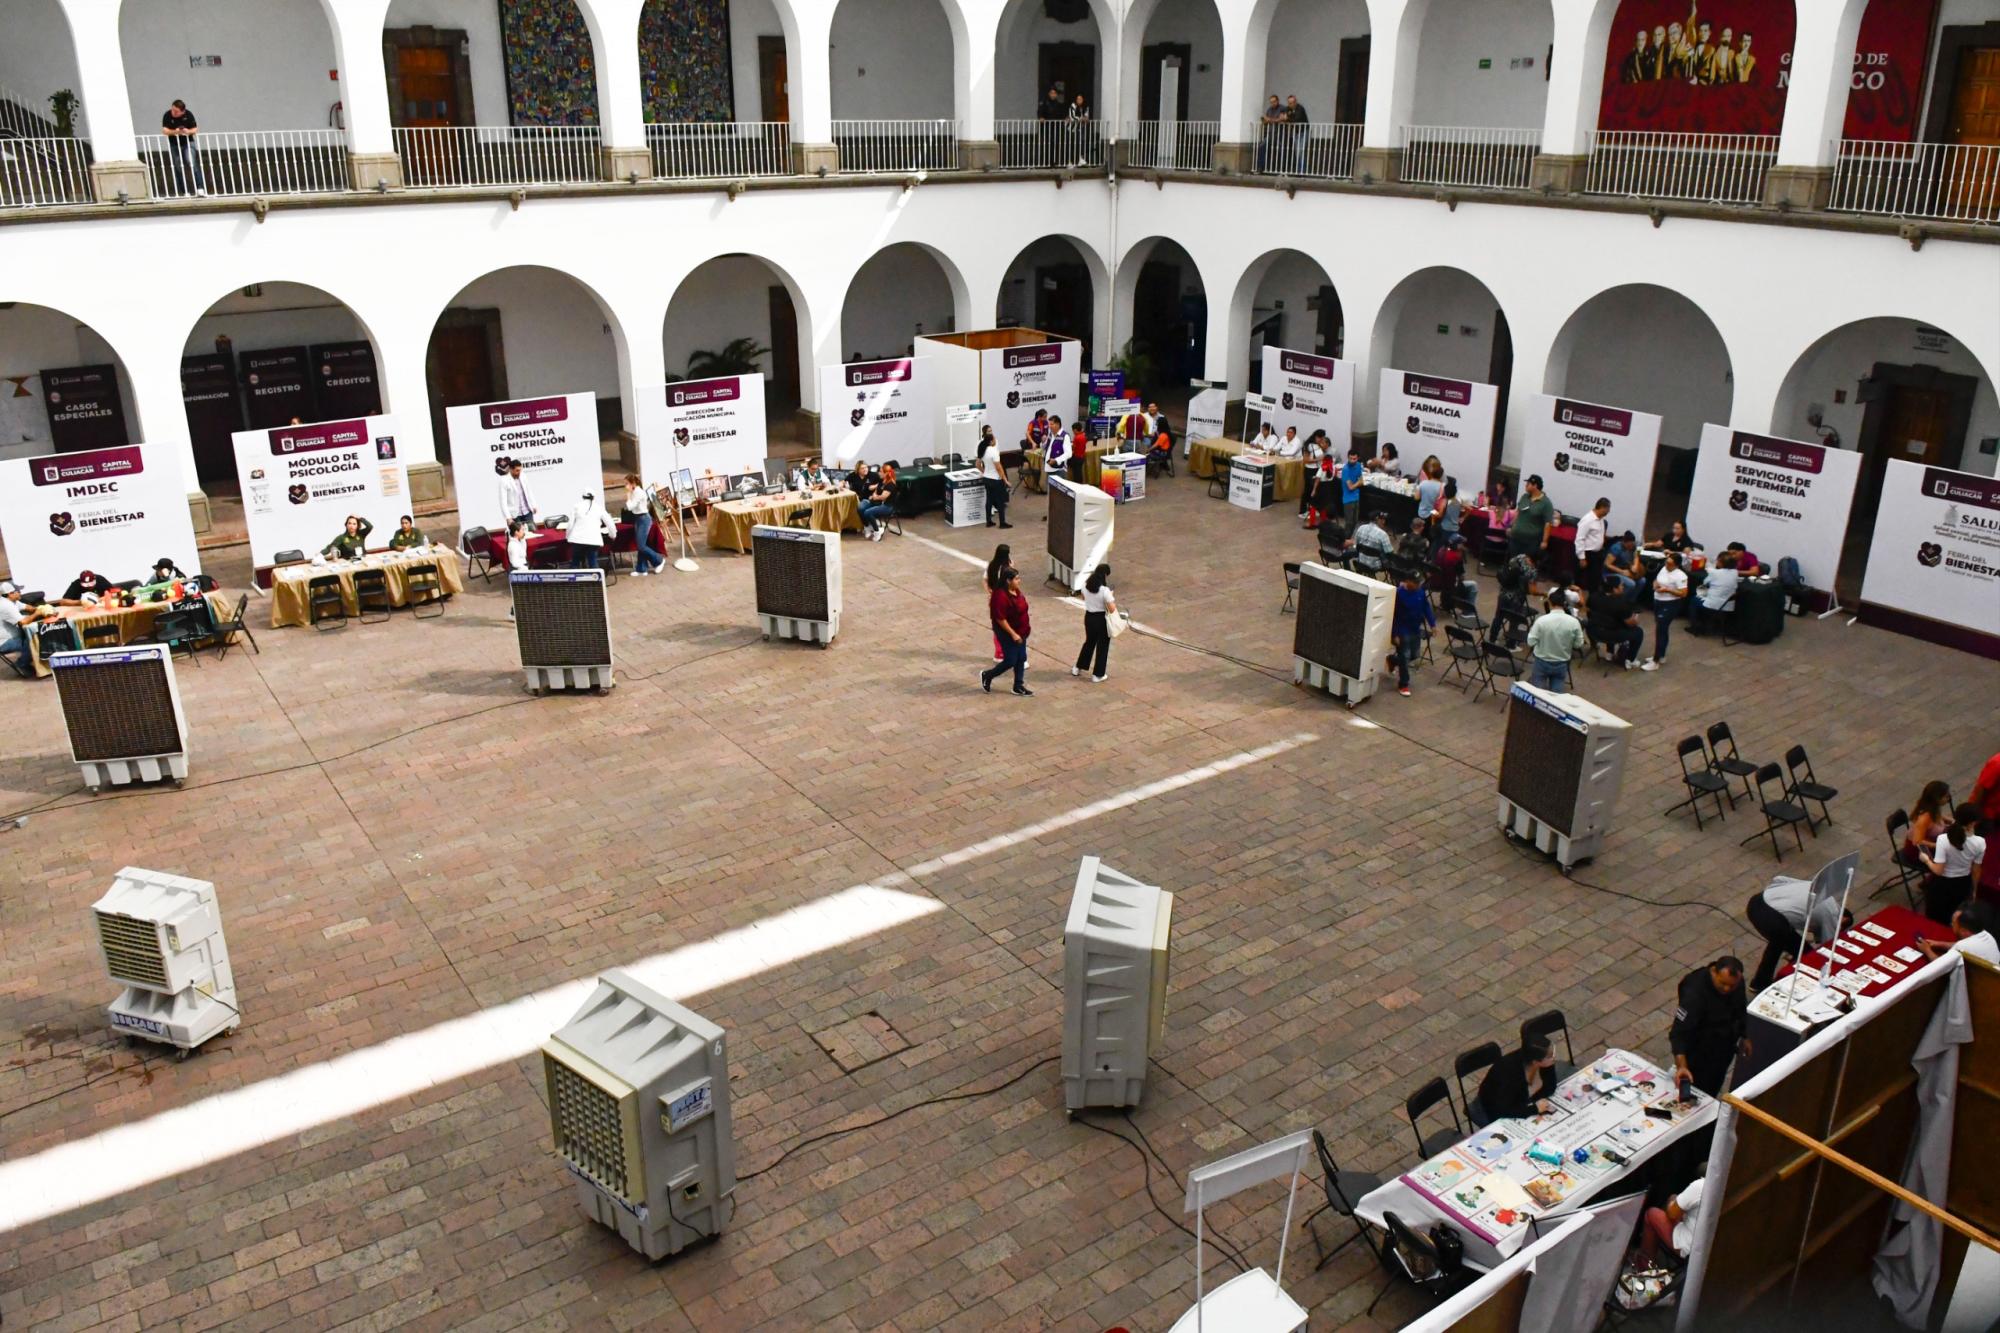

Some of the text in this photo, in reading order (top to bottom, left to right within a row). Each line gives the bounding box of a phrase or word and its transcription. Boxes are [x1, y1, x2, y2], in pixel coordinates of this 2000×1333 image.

[1866, 53, 1888, 64] DE
[255, 384, 301, 396] REGISTRO
[1022, 394, 1056, 403] BIENESTAR
[66, 402, 98, 411] CASOS
[1296, 402, 1328, 414] BIENESTAR
[1410, 402, 1461, 418] FARMACIA
[54, 409, 112, 421] ESPECIALES
[332, 431, 358, 439] CAPITAL
[500, 428, 555, 442] CONSULTA
[693, 430, 736, 440] BIENESTAR
[1422, 426, 1459, 438] BIENESTAR
[1565, 431, 1614, 447] CONSULTA
[491, 436, 565, 452] DE NUTRICIÓN
[1569, 441, 1606, 455] MÉDICA
[102, 460, 131, 468] CAPITAL
[288, 452, 359, 468] MÓDULO DE
[521, 458, 563, 468] IENESTAR
[289, 462, 360, 478] PSICOLOGÍA
[1572, 464, 1614, 478] BIENESTAR
[1735, 465, 1811, 488] SERVICIOS DE
[66, 482, 118, 498] IMDEC
[312, 485, 365, 497] BIENESTAR
[1736, 475, 1806, 497] ENFERMERÍA
[1751, 503, 1801, 520] BIENESTAR
[79, 512, 145, 528] BIENESTAR
[1962, 515, 2000, 530] SALU
[1948, 550, 1987, 564] FERIA DEL
[53, 656, 87, 666] RENTA
